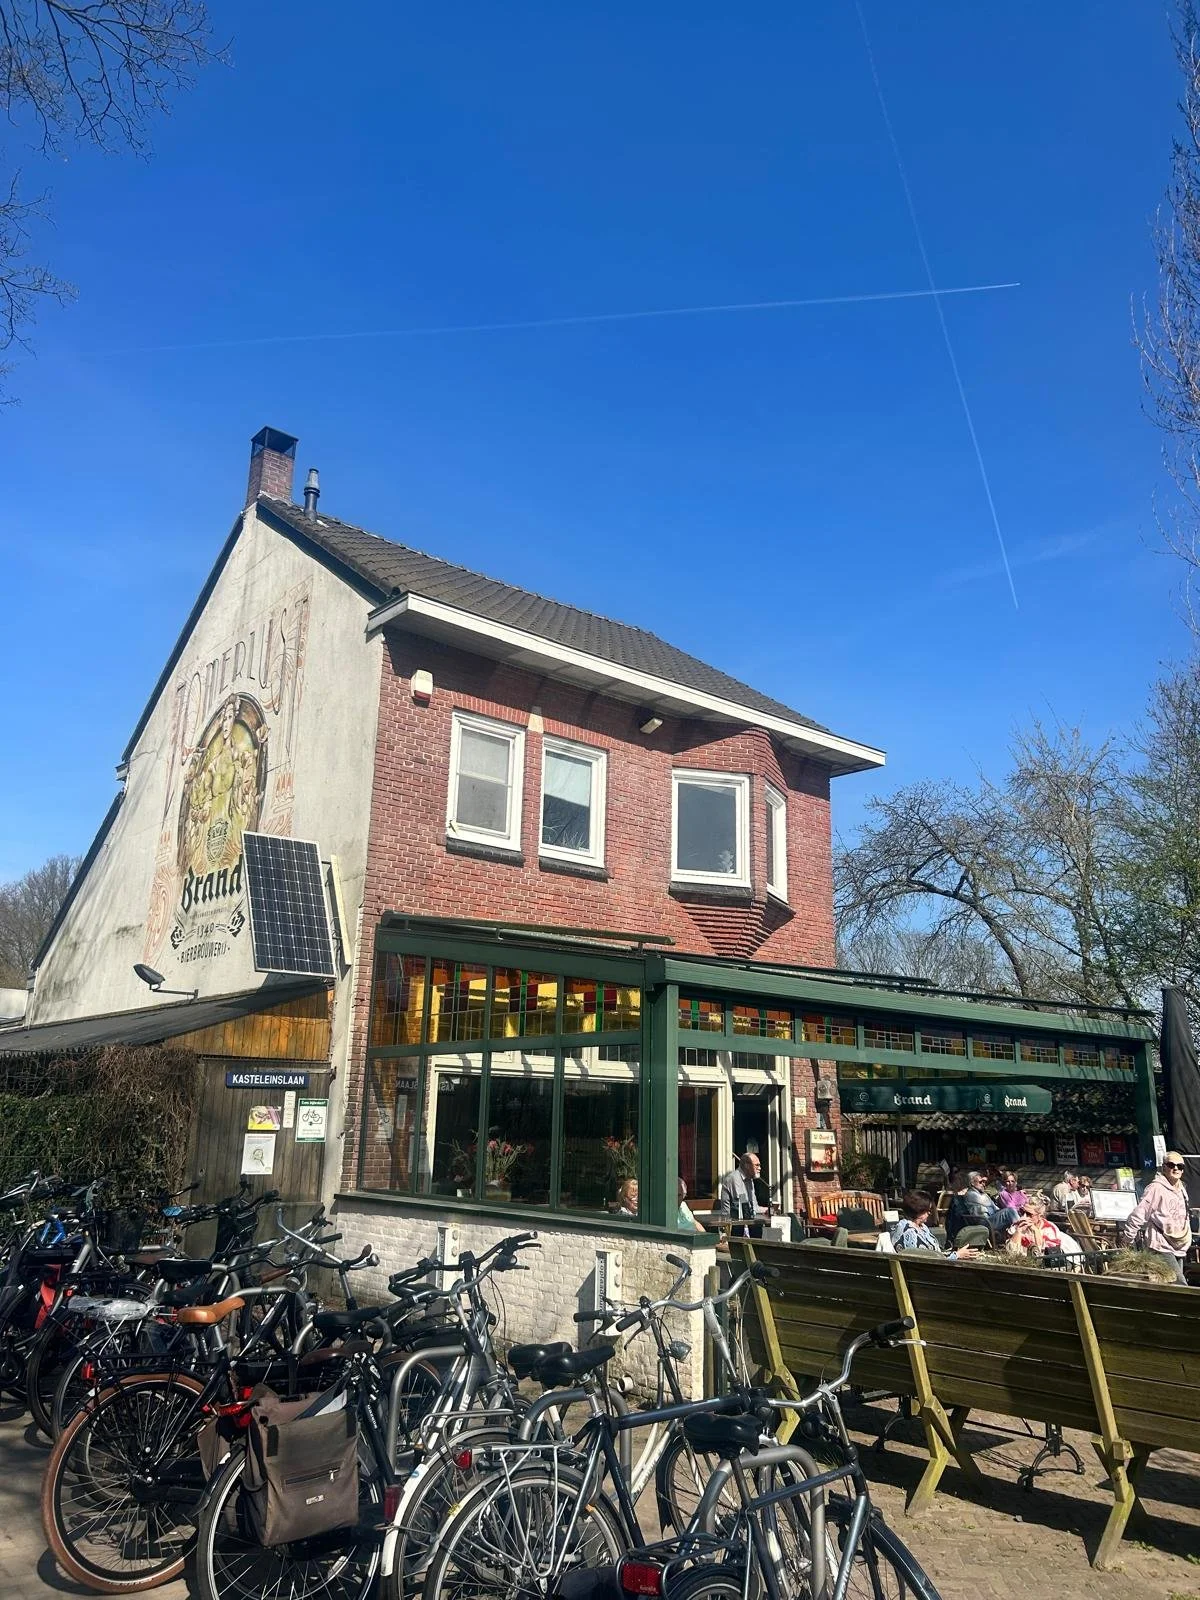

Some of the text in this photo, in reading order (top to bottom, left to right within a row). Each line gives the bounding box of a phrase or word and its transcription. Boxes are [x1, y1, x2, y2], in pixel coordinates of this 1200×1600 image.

[181, 854, 243, 914] Brand
[197, 922, 215, 938] 1340
[180, 941, 227, 963] BIERBROUWERIJ
[232, 1074, 305, 1085] KASTELEINSLAAN
[893, 1093, 932, 1106] Brand
[1005, 1095, 1027, 1107] Brand
